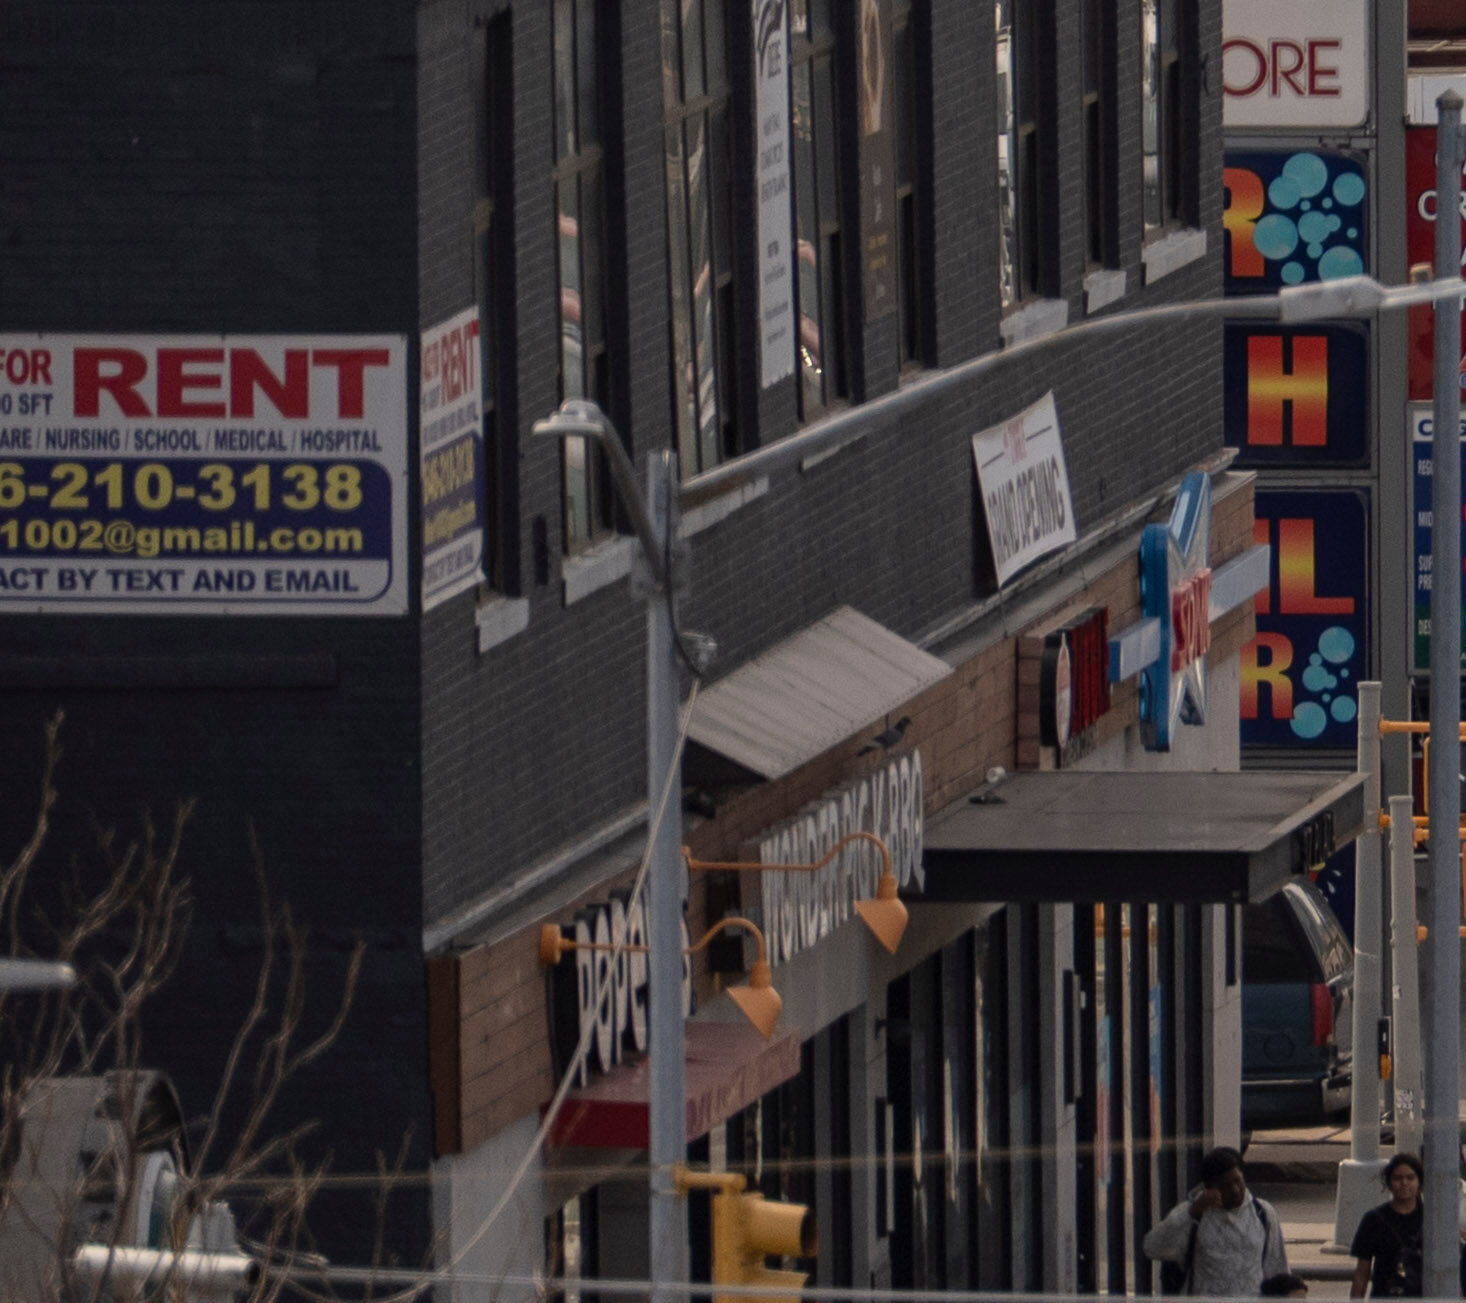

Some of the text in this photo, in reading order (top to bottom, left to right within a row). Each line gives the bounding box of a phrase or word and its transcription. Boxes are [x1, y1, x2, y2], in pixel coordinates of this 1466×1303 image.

[73, 347, 390, 419] RENT
[18, 393, 54, 417] SFT
[44, 428, 121, 451] NURSING
[134, 429, 201, 453] SCHOOL
[214, 429, 287, 452] MEDICAL
[300, 429, 382, 453] HOSPITAL
[0, 463, 364, 511] 6-210-3138
[1, 519, 364, 559] 1002@gmail.com
[56, 568, 97, 593] BY
[106, 568, 185, 593] TEXT
[192, 568, 257, 593] AND
[264, 568, 360, 594] EMAIL
[760, 800, 842, 969] WONDER
